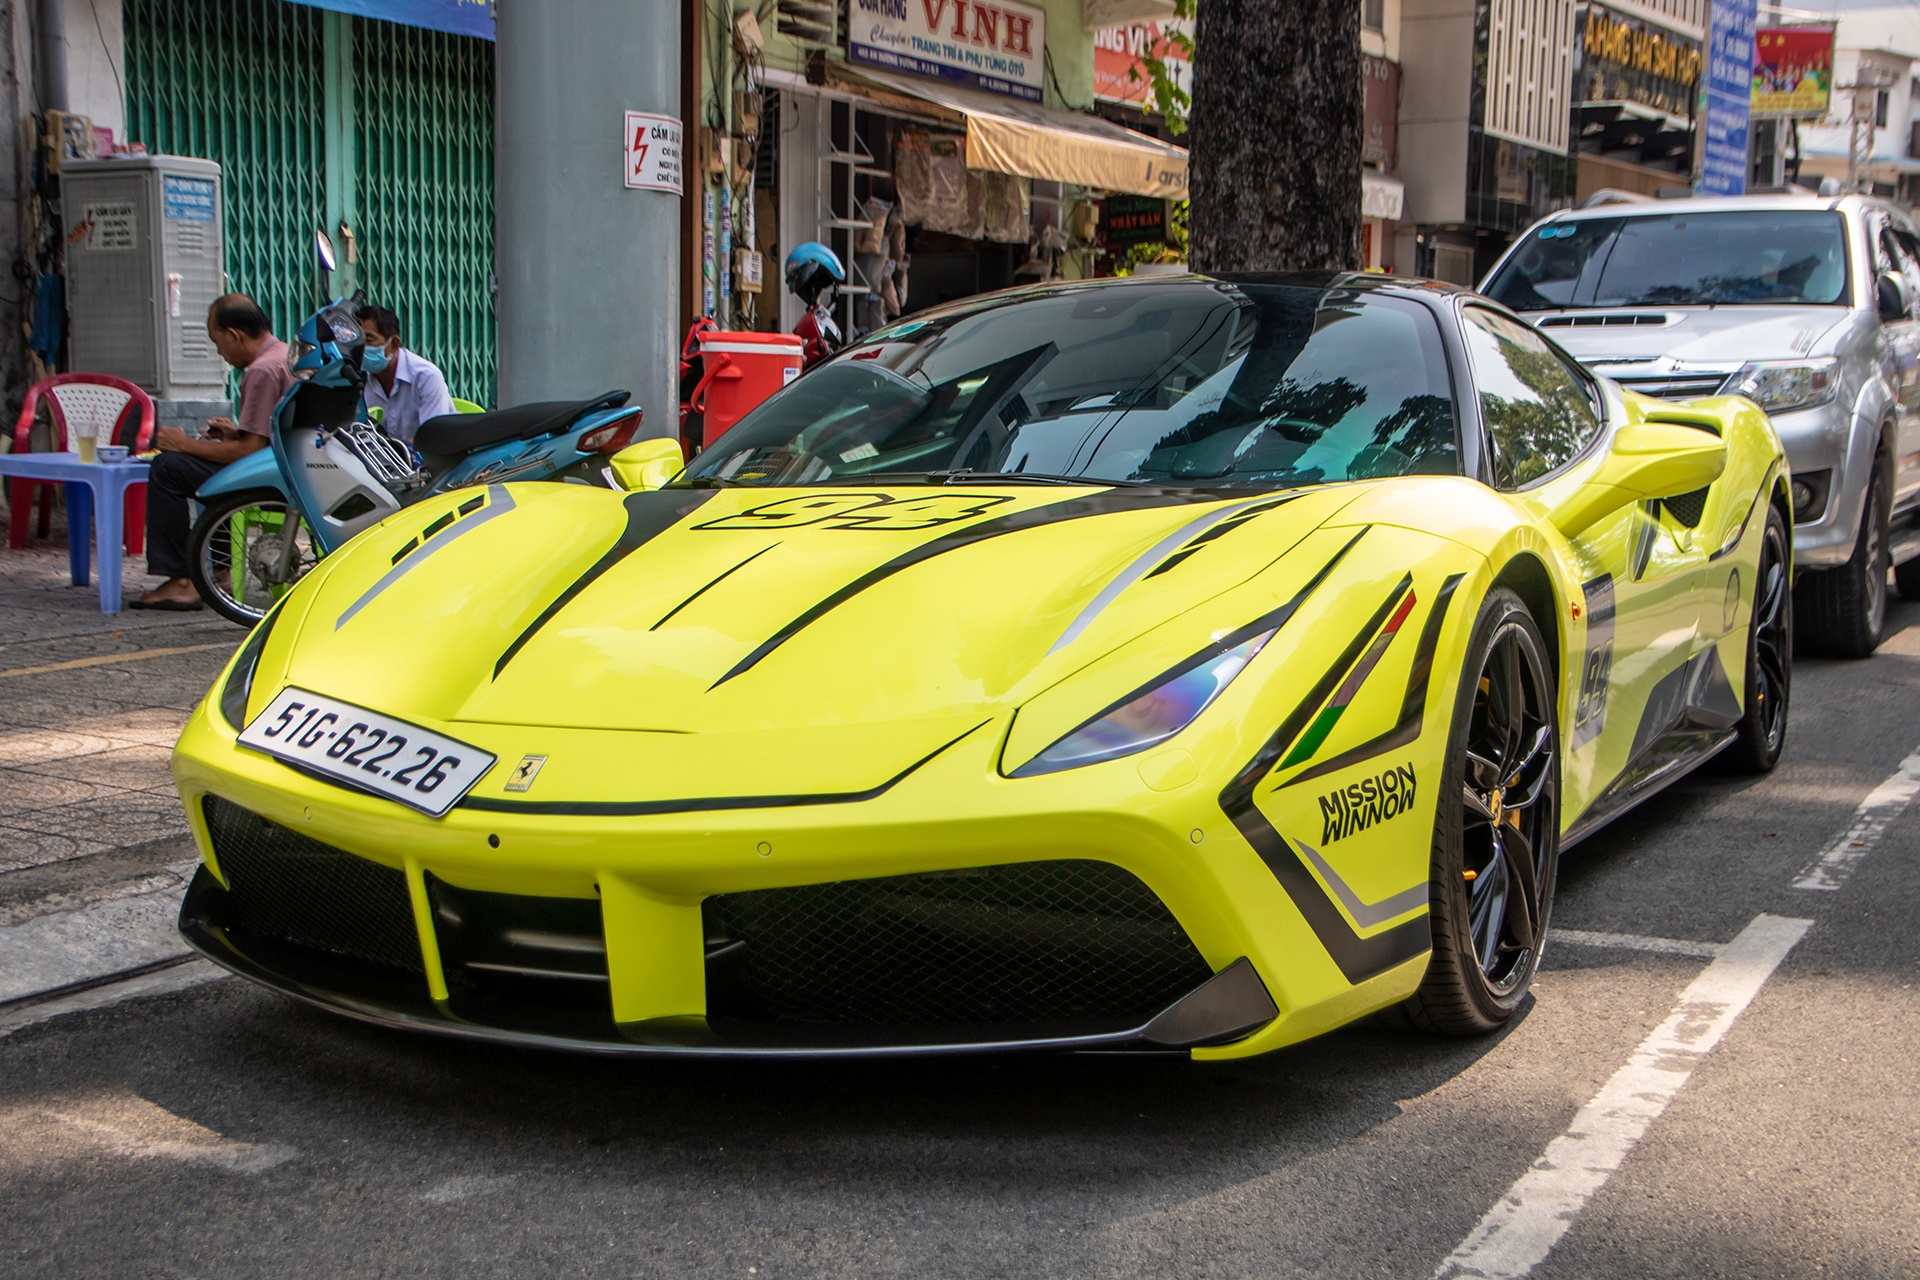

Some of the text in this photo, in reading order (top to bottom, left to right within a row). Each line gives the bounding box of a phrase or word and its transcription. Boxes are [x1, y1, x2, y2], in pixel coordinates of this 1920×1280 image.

[911, 36, 941, 57] TRANG
[942, 43, 957, 61] TRÍ
[965, 49, 983, 70] PHỤ
[985, 52, 1006, 75] TÙNG
[921, 0, 1033, 60] VINH
[651, 123, 668, 140] CẤM
[264, 701, 462, 794] 51G-622.26
[1318, 761, 1416, 818] MISSION
[1321, 787, 1416, 847] WINNOW
